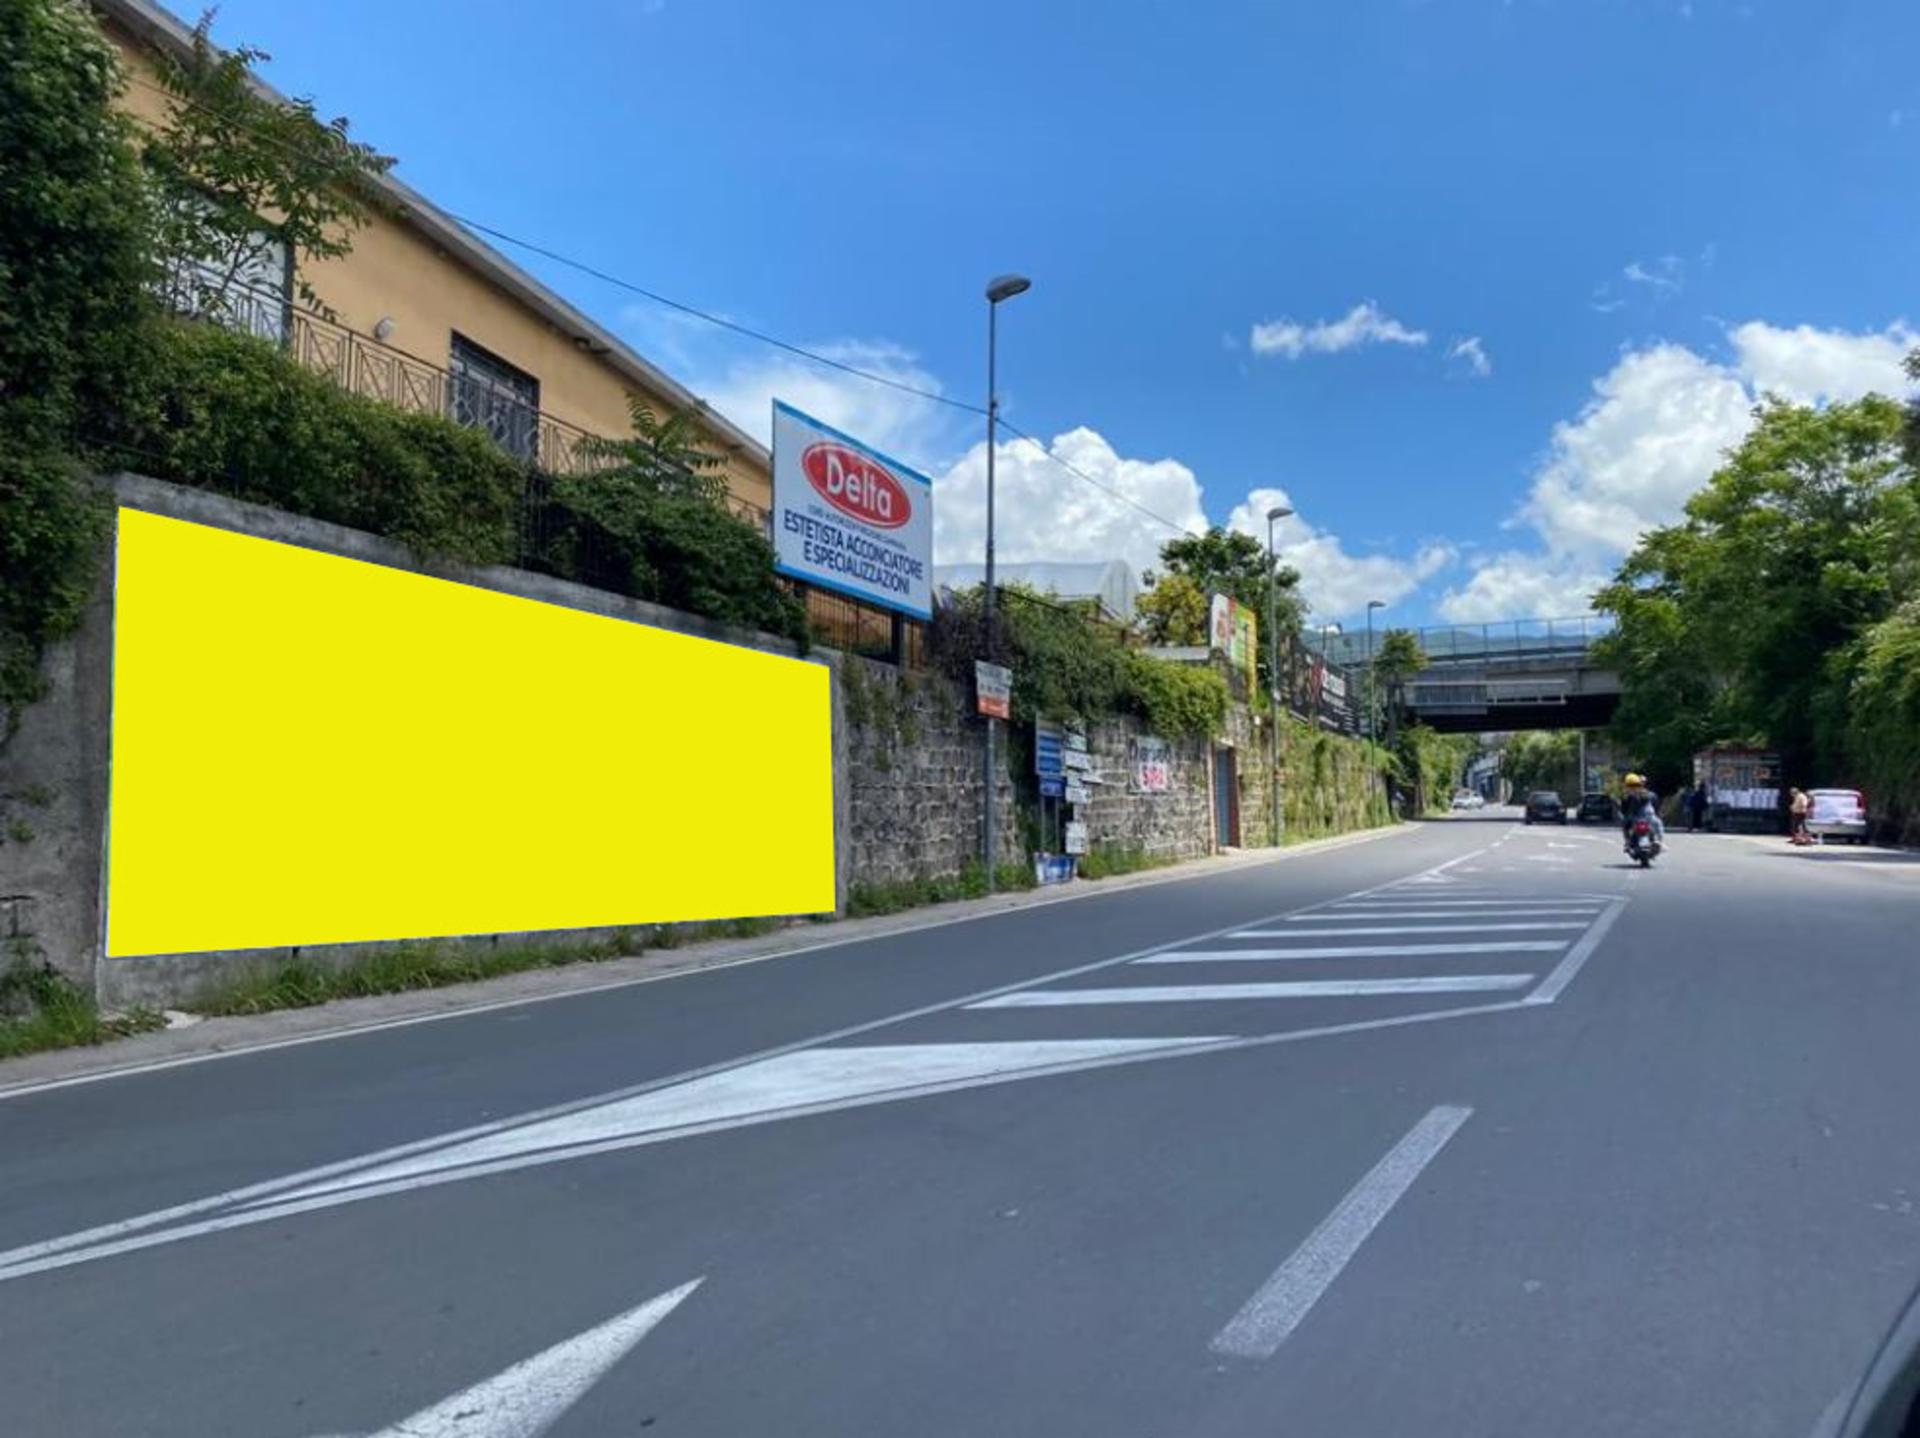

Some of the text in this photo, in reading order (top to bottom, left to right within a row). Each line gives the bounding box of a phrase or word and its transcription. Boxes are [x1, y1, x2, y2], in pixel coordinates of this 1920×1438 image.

[826, 452, 892, 519] Delta
[784, 508, 844, 550] ESTETISTA
[847, 533, 923, 580] ACCONCIATORE
[804, 540, 910, 594] E SPECIALIZZAZIONI
